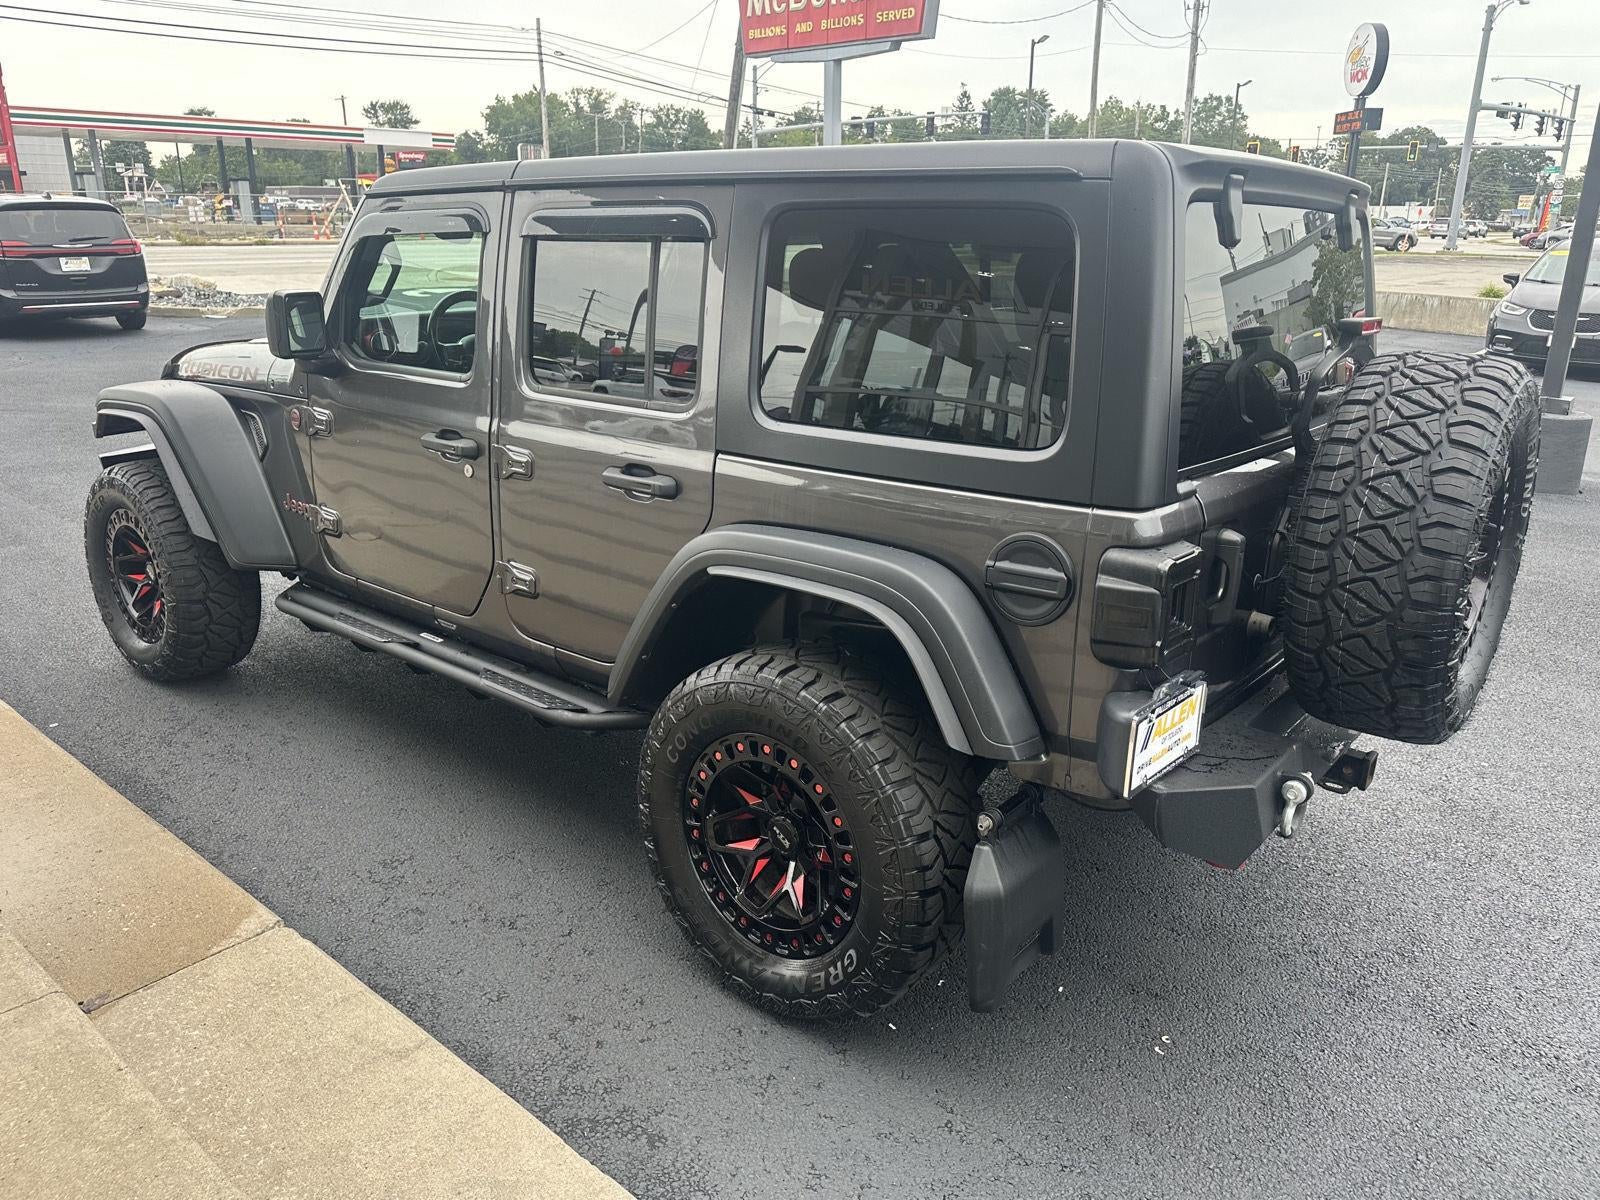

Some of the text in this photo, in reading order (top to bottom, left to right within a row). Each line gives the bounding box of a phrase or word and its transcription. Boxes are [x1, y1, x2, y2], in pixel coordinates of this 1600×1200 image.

[748, 7, 915, 40] BILLIONS AND BILLIONS SERVED
[183, 356, 259, 384] RUBICON
[1152, 694, 1199, 742] ALLEN
